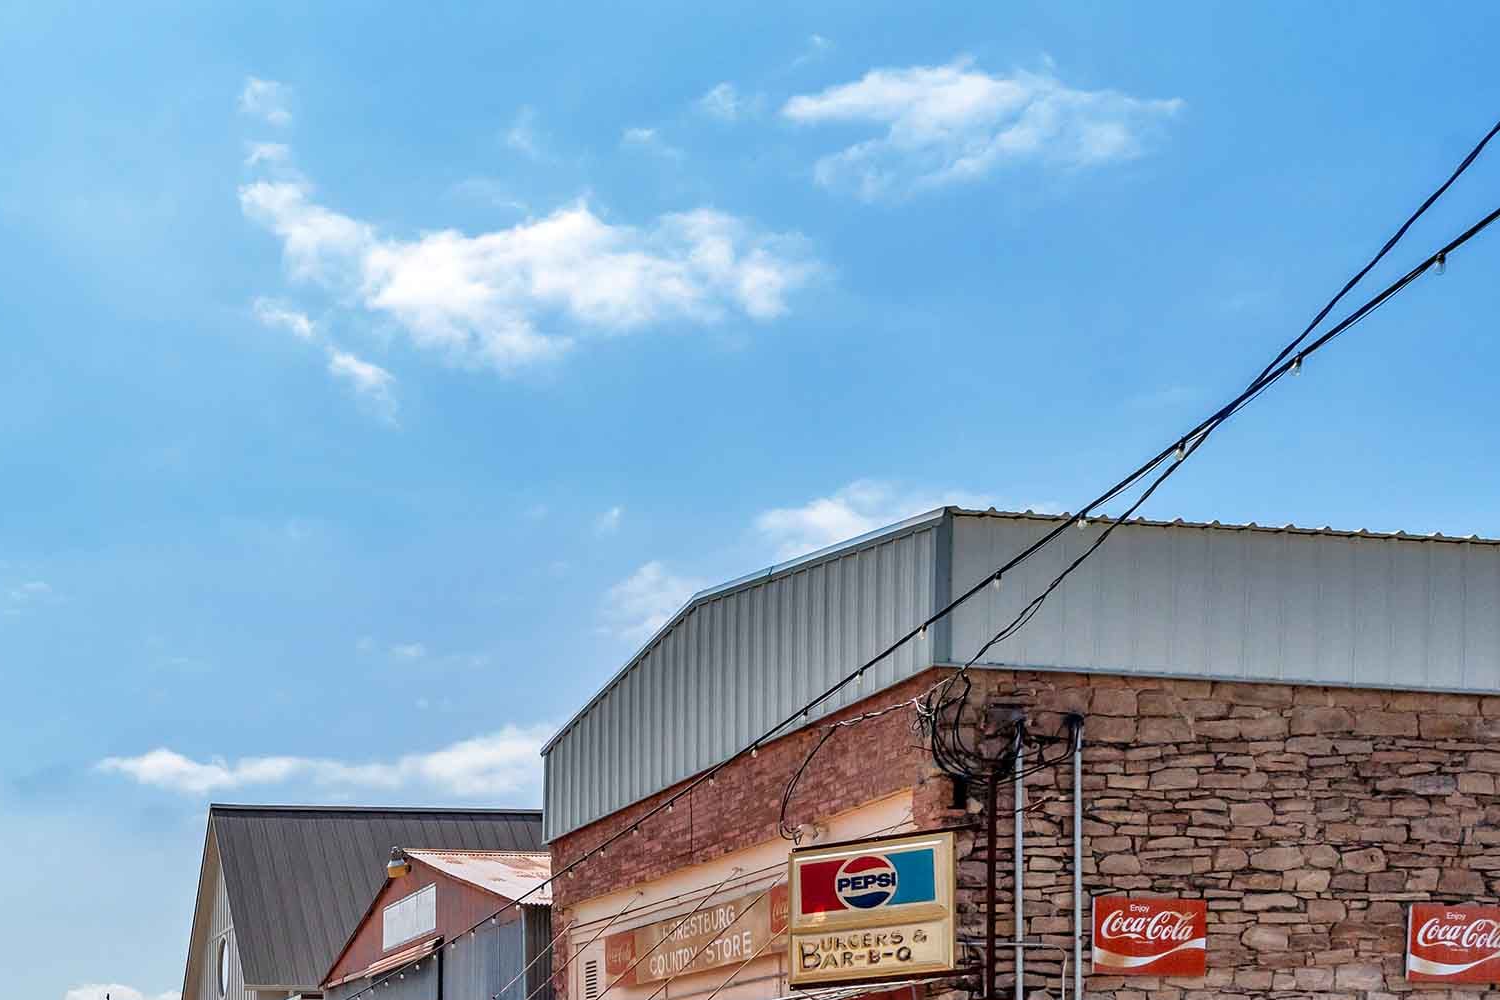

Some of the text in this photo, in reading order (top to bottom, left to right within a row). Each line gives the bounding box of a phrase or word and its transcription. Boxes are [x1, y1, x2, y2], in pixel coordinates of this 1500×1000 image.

[837, 872, 896, 892] PEPSI
[1129, 904, 1150, 913] Enjoy
[1446, 911, 1467, 920] Enjoy
[662, 905, 736, 945] FORESTBURG
[1101, 909, 1198, 941] Coca-Cola
[912, 929, 928, 943] &
[649, 931, 752, 976] COUNTRY STORE
